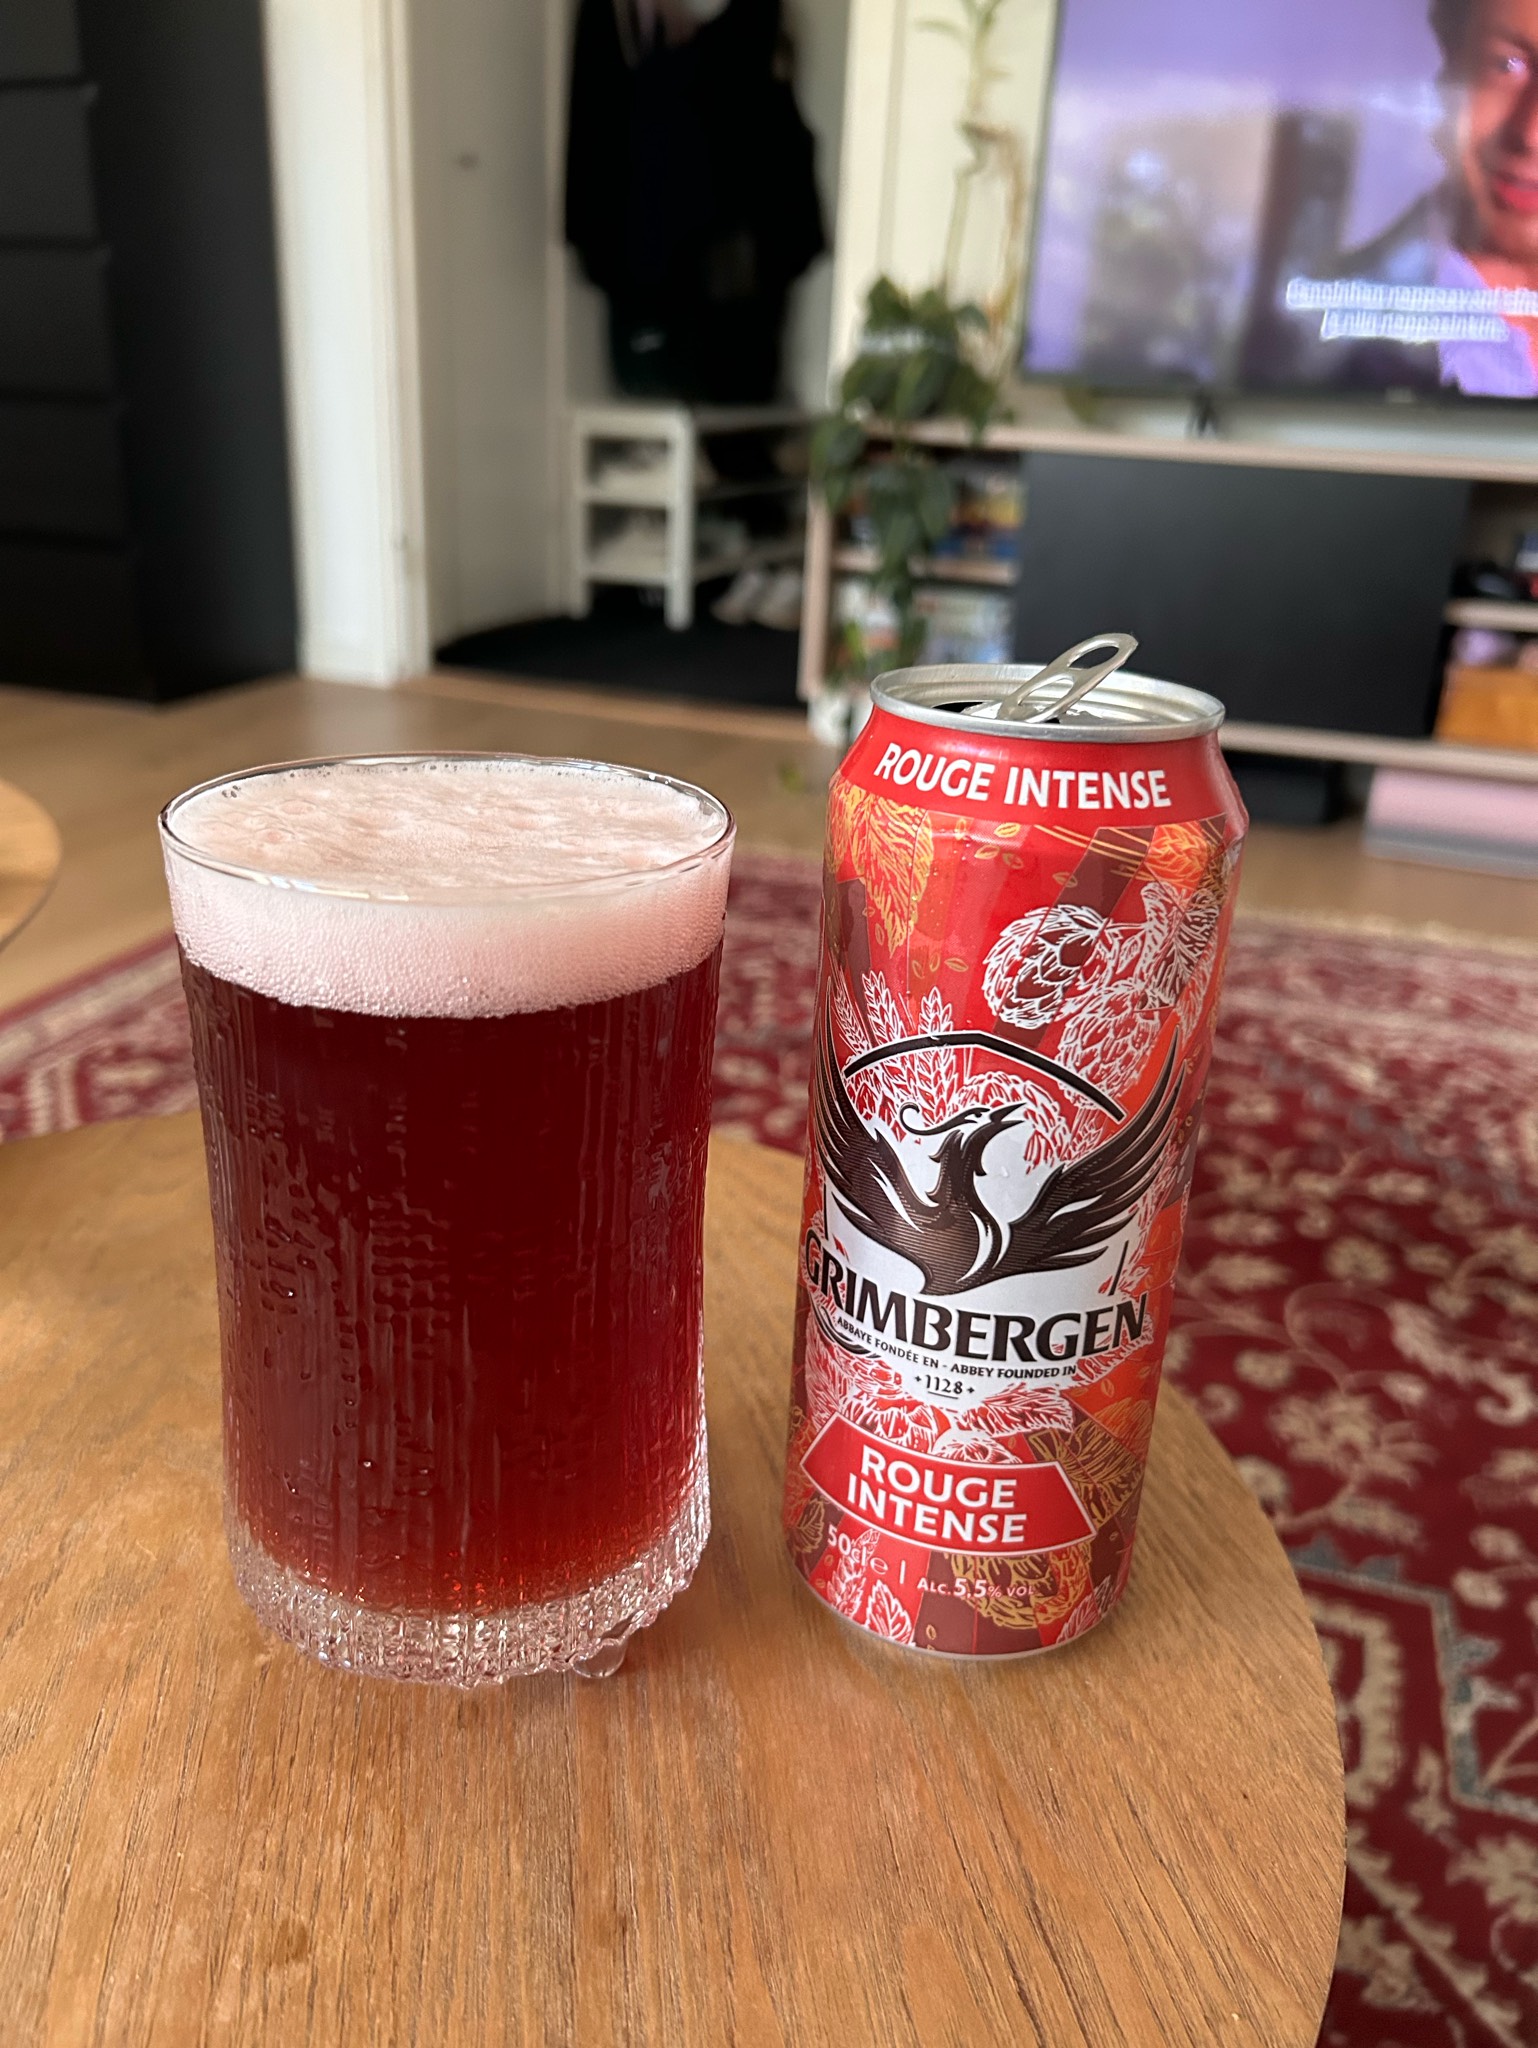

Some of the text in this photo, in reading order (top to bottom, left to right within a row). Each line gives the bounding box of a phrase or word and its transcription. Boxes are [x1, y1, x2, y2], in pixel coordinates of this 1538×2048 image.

[873, 741, 1172, 810] ROUGE INTENSE
[803, 1229, 1148, 1363] GRIMBERGEN
[836, 1316, 873, 1345] ABBAYE
[875, 1337, 919, 1363] FONDÉE
[922, 1355, 940, 1369] EN
[950, 1363, 994, 1378] ABBEY
[997, 1367, 1060, 1379] FOUNDED
[1062, 1365, 1077, 1376] IN
[924, 1374, 963, 1395] 1128
[846, 1472, 1028, 1545] INTENSE
[860, 1443, 1018, 1510] ROUGE
